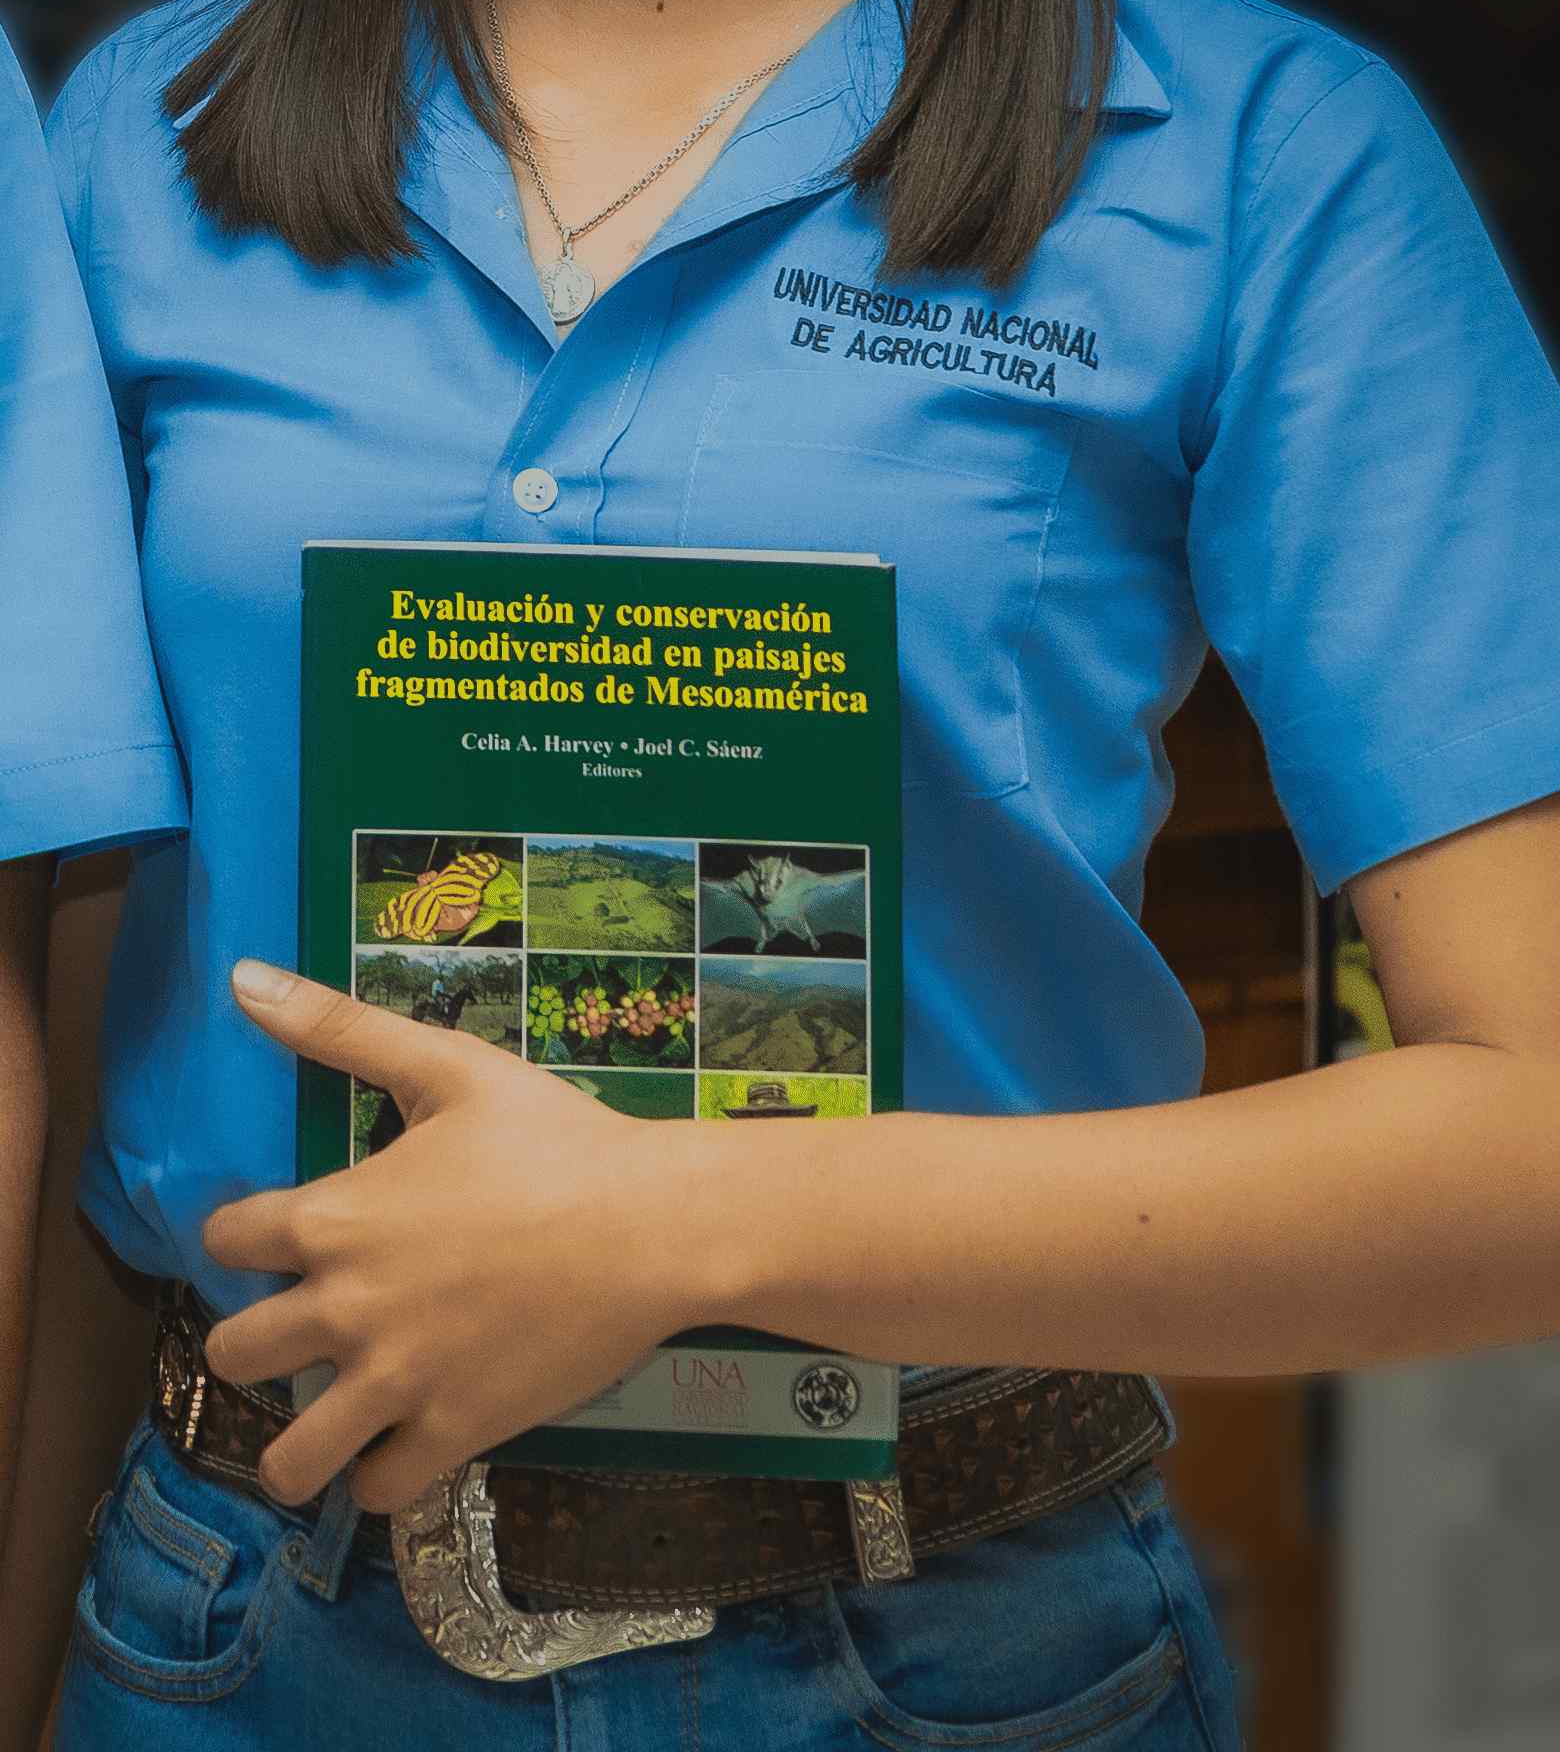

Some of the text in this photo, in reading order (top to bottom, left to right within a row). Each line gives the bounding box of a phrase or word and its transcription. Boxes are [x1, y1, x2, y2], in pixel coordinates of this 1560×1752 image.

[774, 266, 1099, 370] UNIVERSIDAD NACIONAL
[791, 317, 1056, 398] DE AGRICULTURA
[390, 590, 832, 633] Evaluación y conservación
[377, 629, 847, 680] de biodiversidad en paisajes
[356, 667, 868, 713] fragmentados de Mesoamérica
[461, 732, 763, 759] Celia A. Harvey Joel C. Sáenz
[582, 762, 642, 779] Editores
[672, 1357, 747, 1389] UNA
